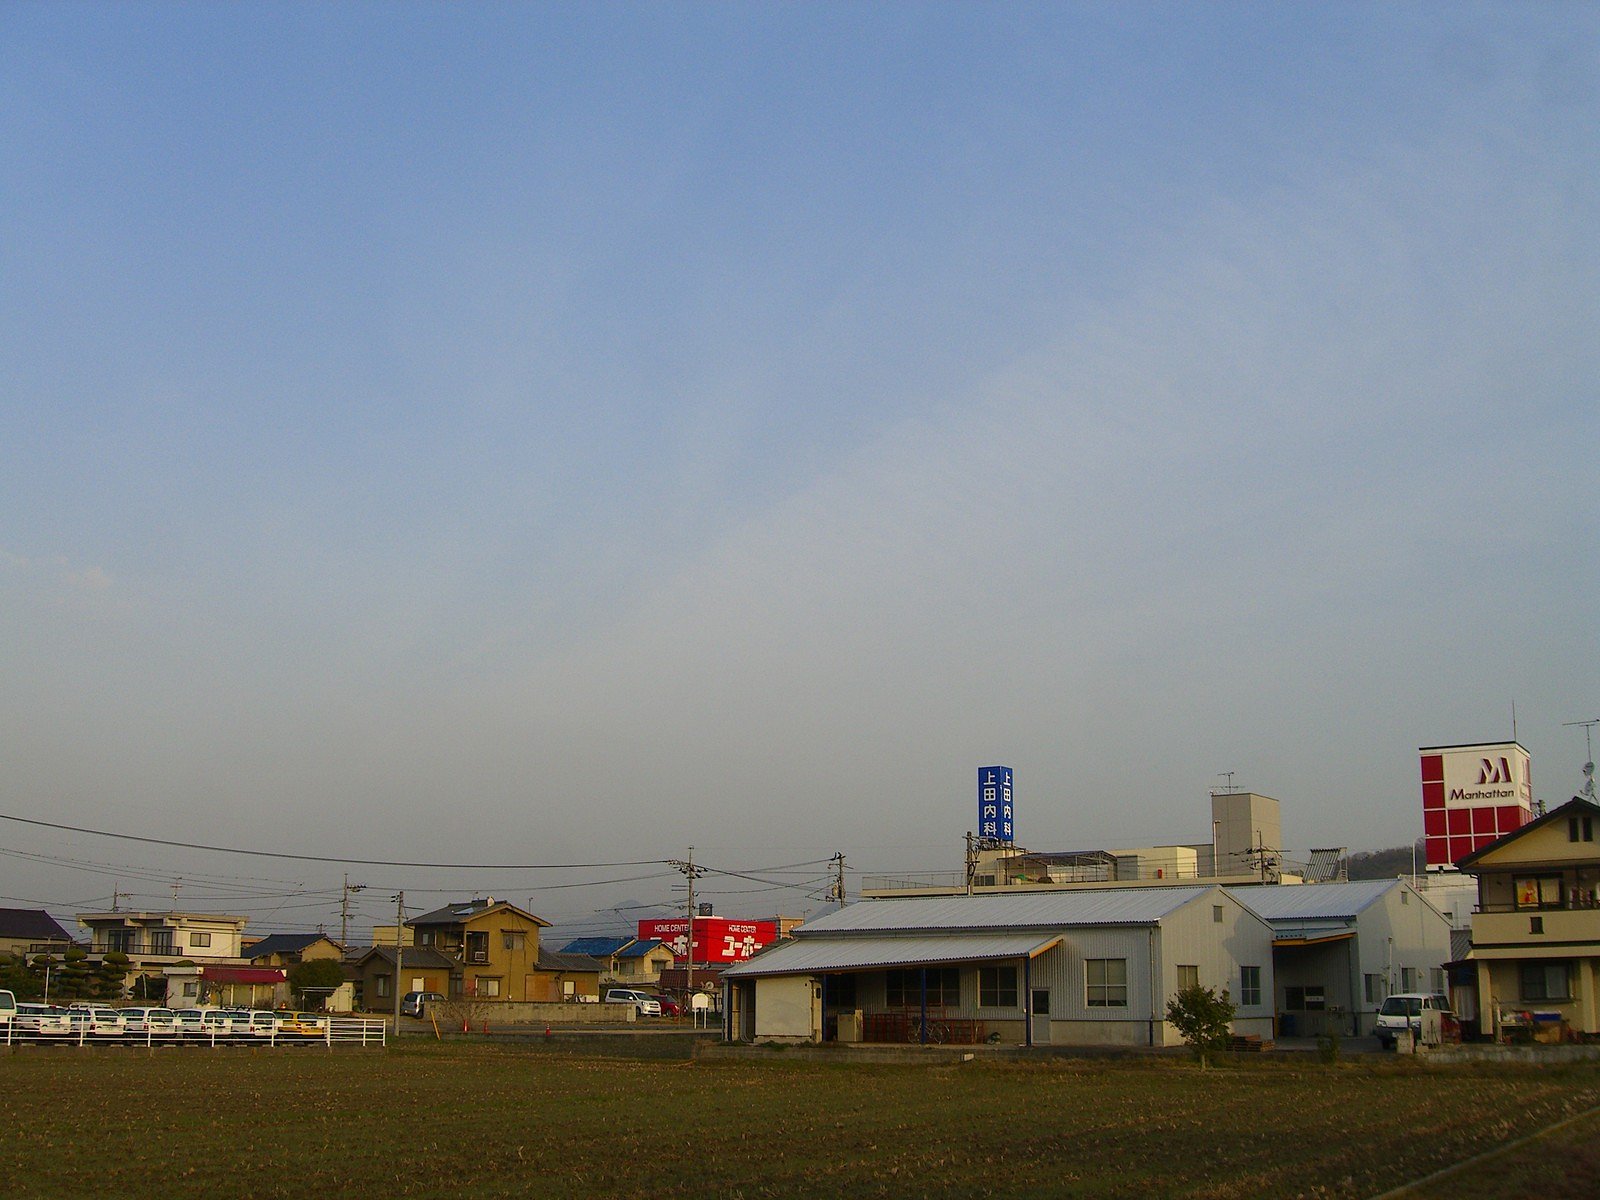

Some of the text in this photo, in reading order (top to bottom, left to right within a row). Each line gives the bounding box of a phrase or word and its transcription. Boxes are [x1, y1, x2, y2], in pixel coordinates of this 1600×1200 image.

[1450, 789, 1514, 800] Manhattan
[983, 771, 997, 836] 上田内科
[1003, 771, 1011, 836] 上田内科
[654, 924, 690, 932] HOME CENTE
[728, 924, 757, 933] HOME CENTER
[722, 935, 763, 956] ユーホー
